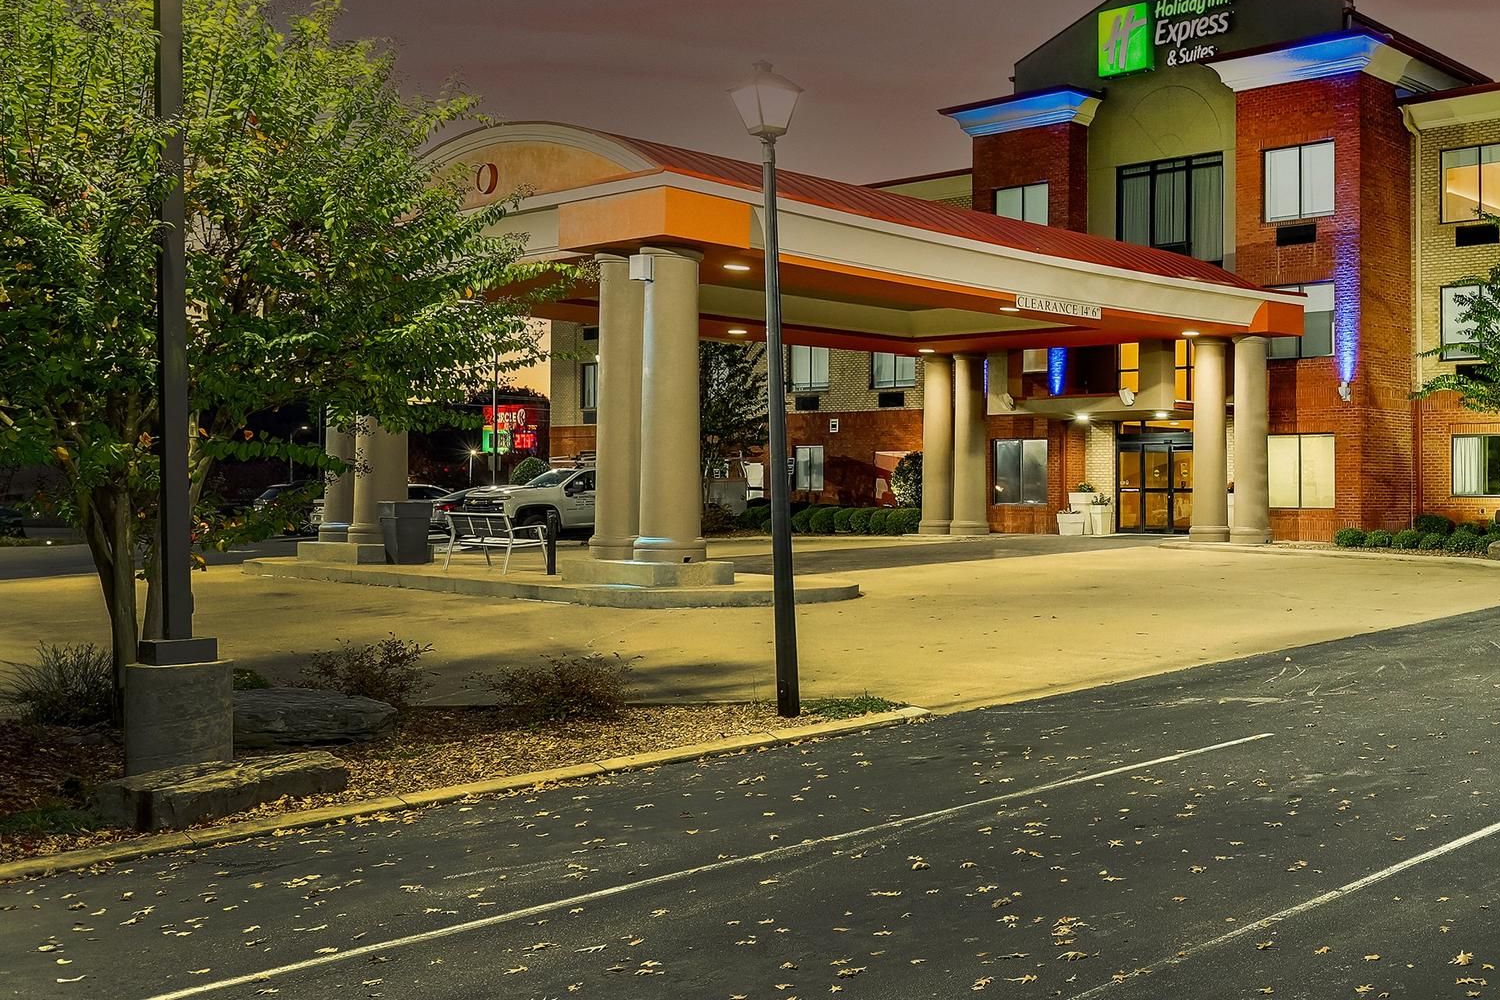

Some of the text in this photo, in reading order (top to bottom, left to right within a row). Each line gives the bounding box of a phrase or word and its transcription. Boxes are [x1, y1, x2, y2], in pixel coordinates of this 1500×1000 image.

[1154, 12, 1229, 47] Express
[1166, 45, 1214, 67] & Suites
[1017, 296, 1078, 315] CLEARANCE
[493, 412, 517, 423] IRCLE
